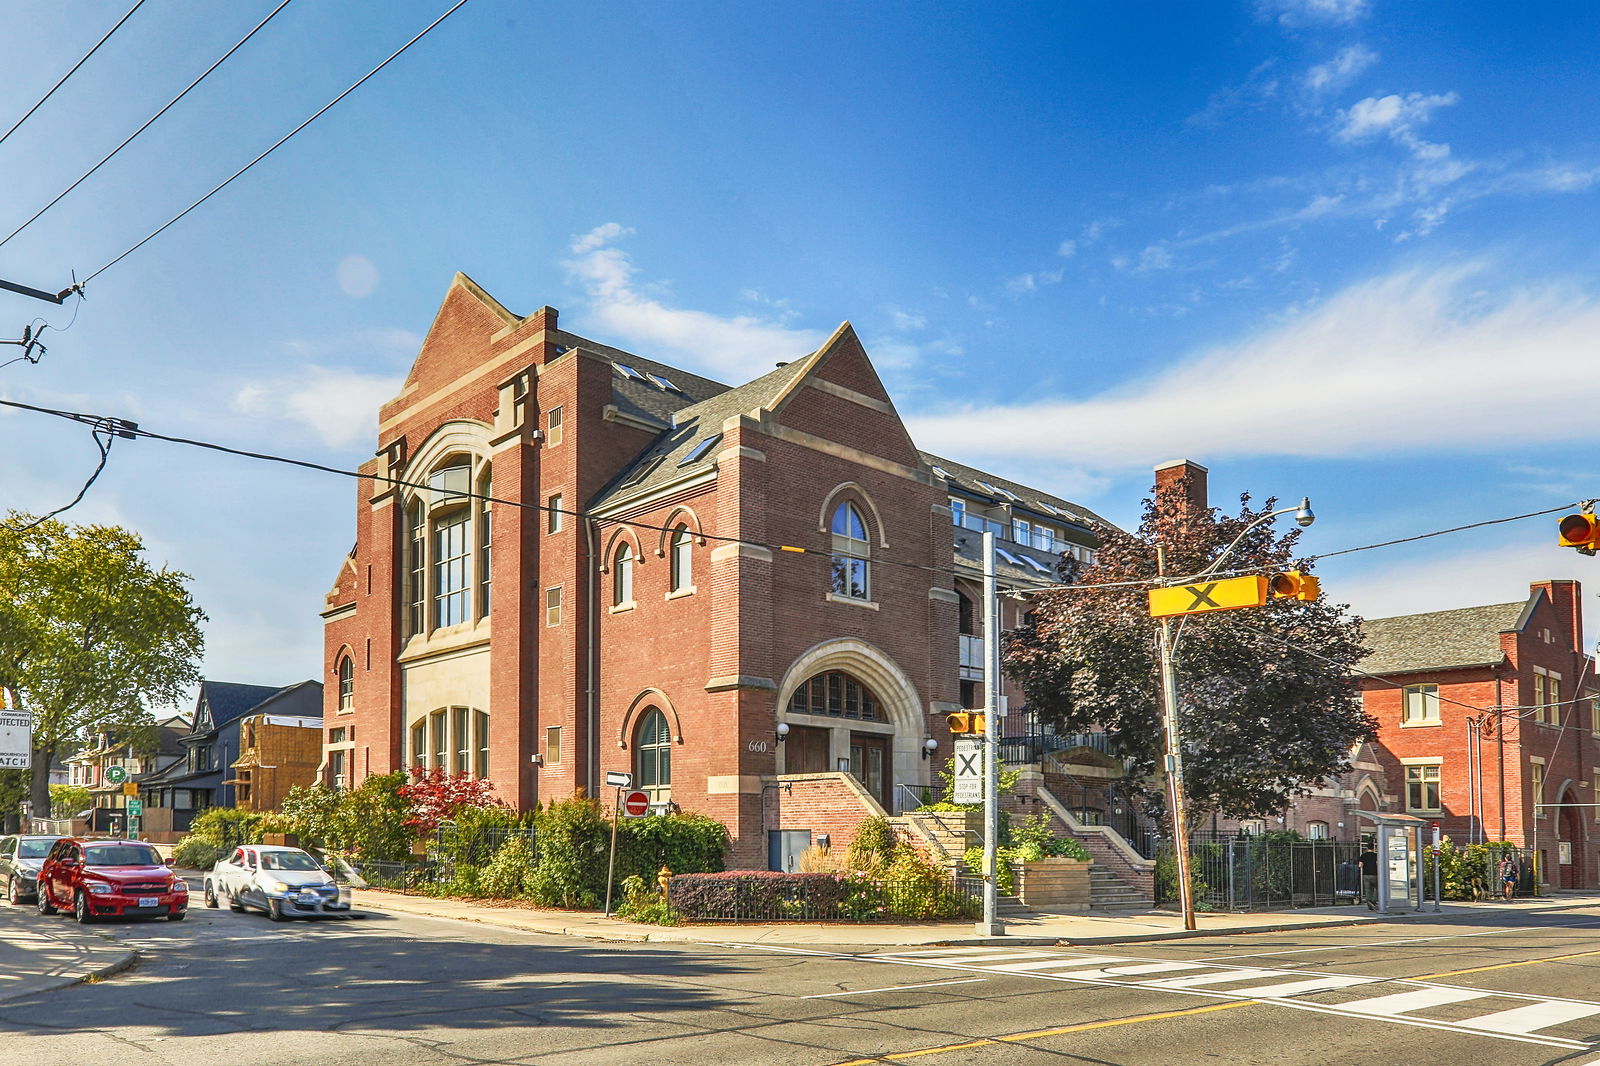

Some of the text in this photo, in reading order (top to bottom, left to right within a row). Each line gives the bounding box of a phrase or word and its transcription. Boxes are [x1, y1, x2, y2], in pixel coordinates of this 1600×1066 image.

[1185, 583, 1221, 611] X
[748, 740, 767, 752] 660
[956, 743, 980, 752] PEDESTR
[958, 753, 978, 776] X
[112, 770, 121, 778] P
